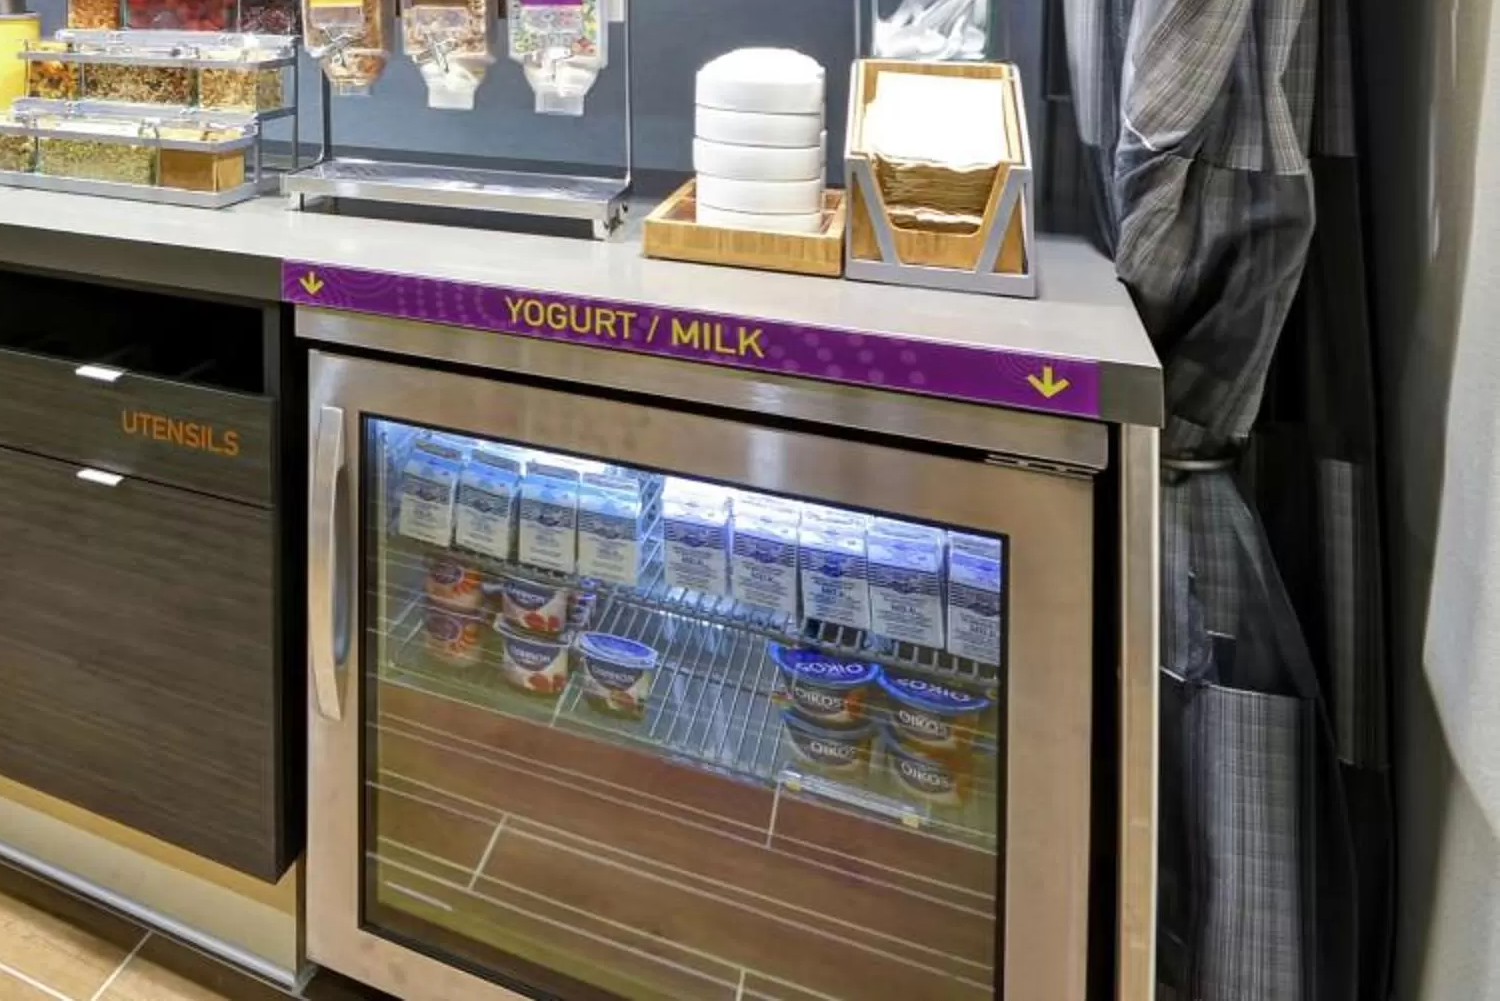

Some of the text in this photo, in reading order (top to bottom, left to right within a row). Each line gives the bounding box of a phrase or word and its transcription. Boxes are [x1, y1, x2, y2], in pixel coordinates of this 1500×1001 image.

[504, 296, 765, 358] YOGURT / MILK
[121, 408, 240, 456] UTENSILS
